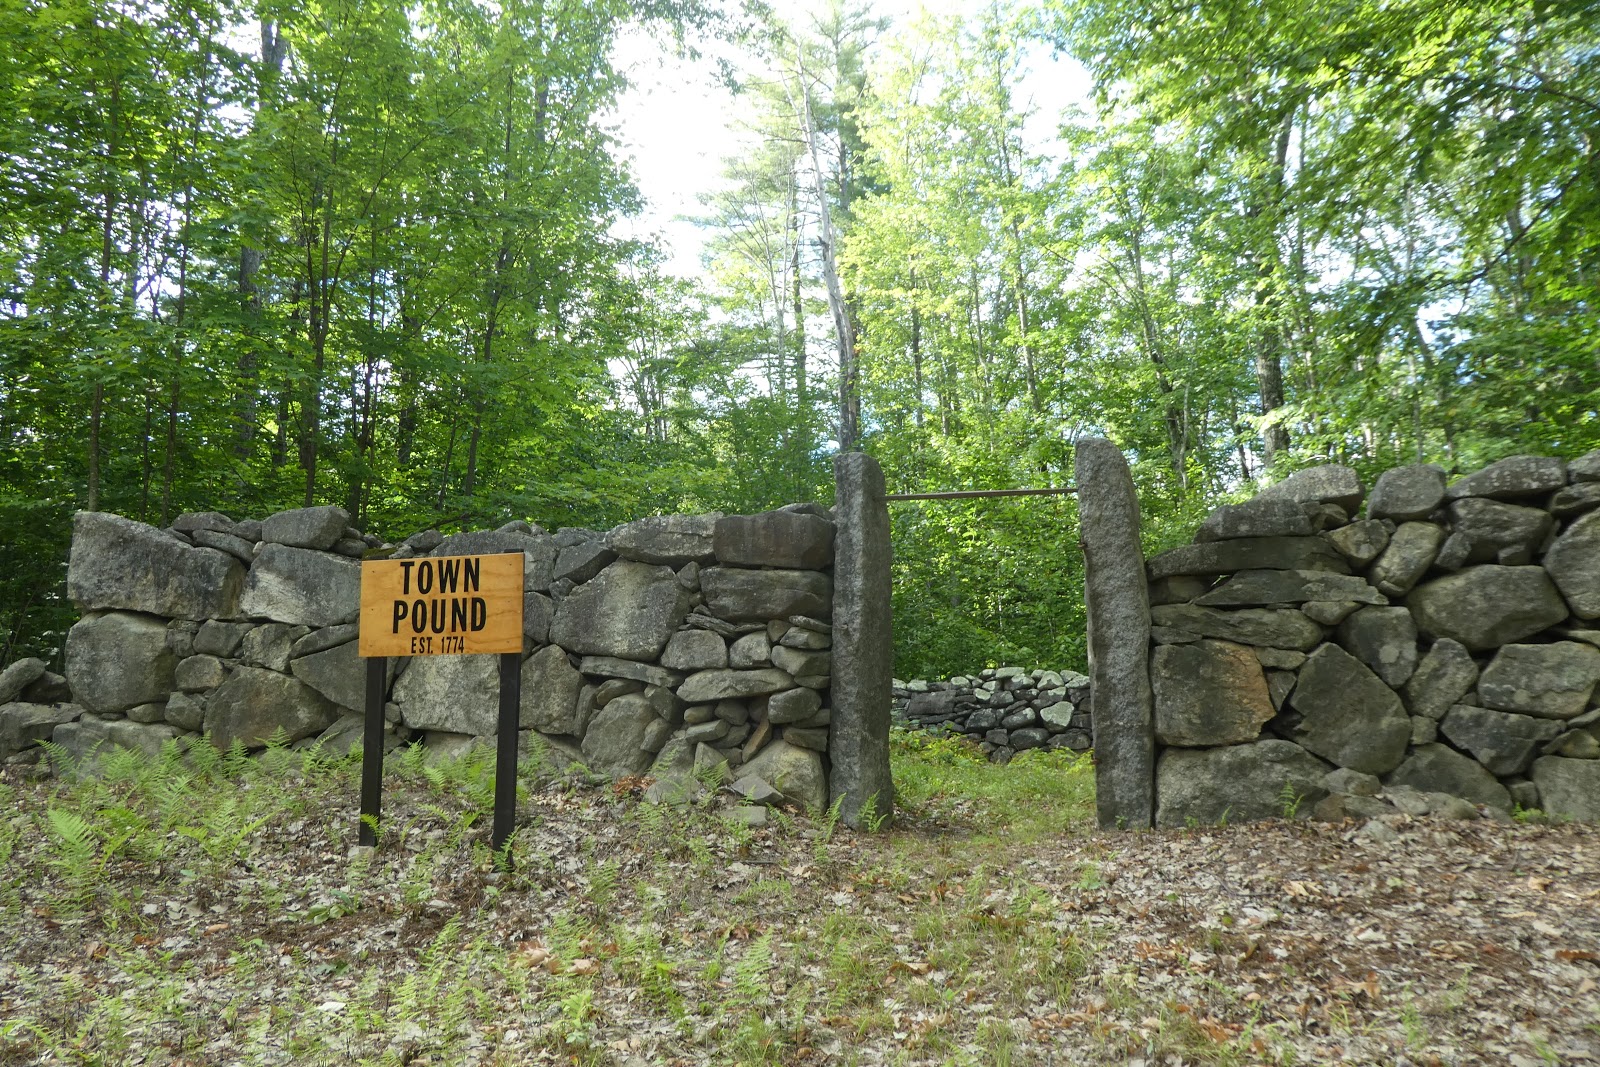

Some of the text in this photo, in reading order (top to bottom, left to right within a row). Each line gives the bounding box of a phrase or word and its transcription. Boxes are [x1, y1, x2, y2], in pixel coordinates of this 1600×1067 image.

[400, 558, 480, 595] TOWN
[392, 597, 487, 634] POUND
[411, 636, 465, 654] EST. 1774
